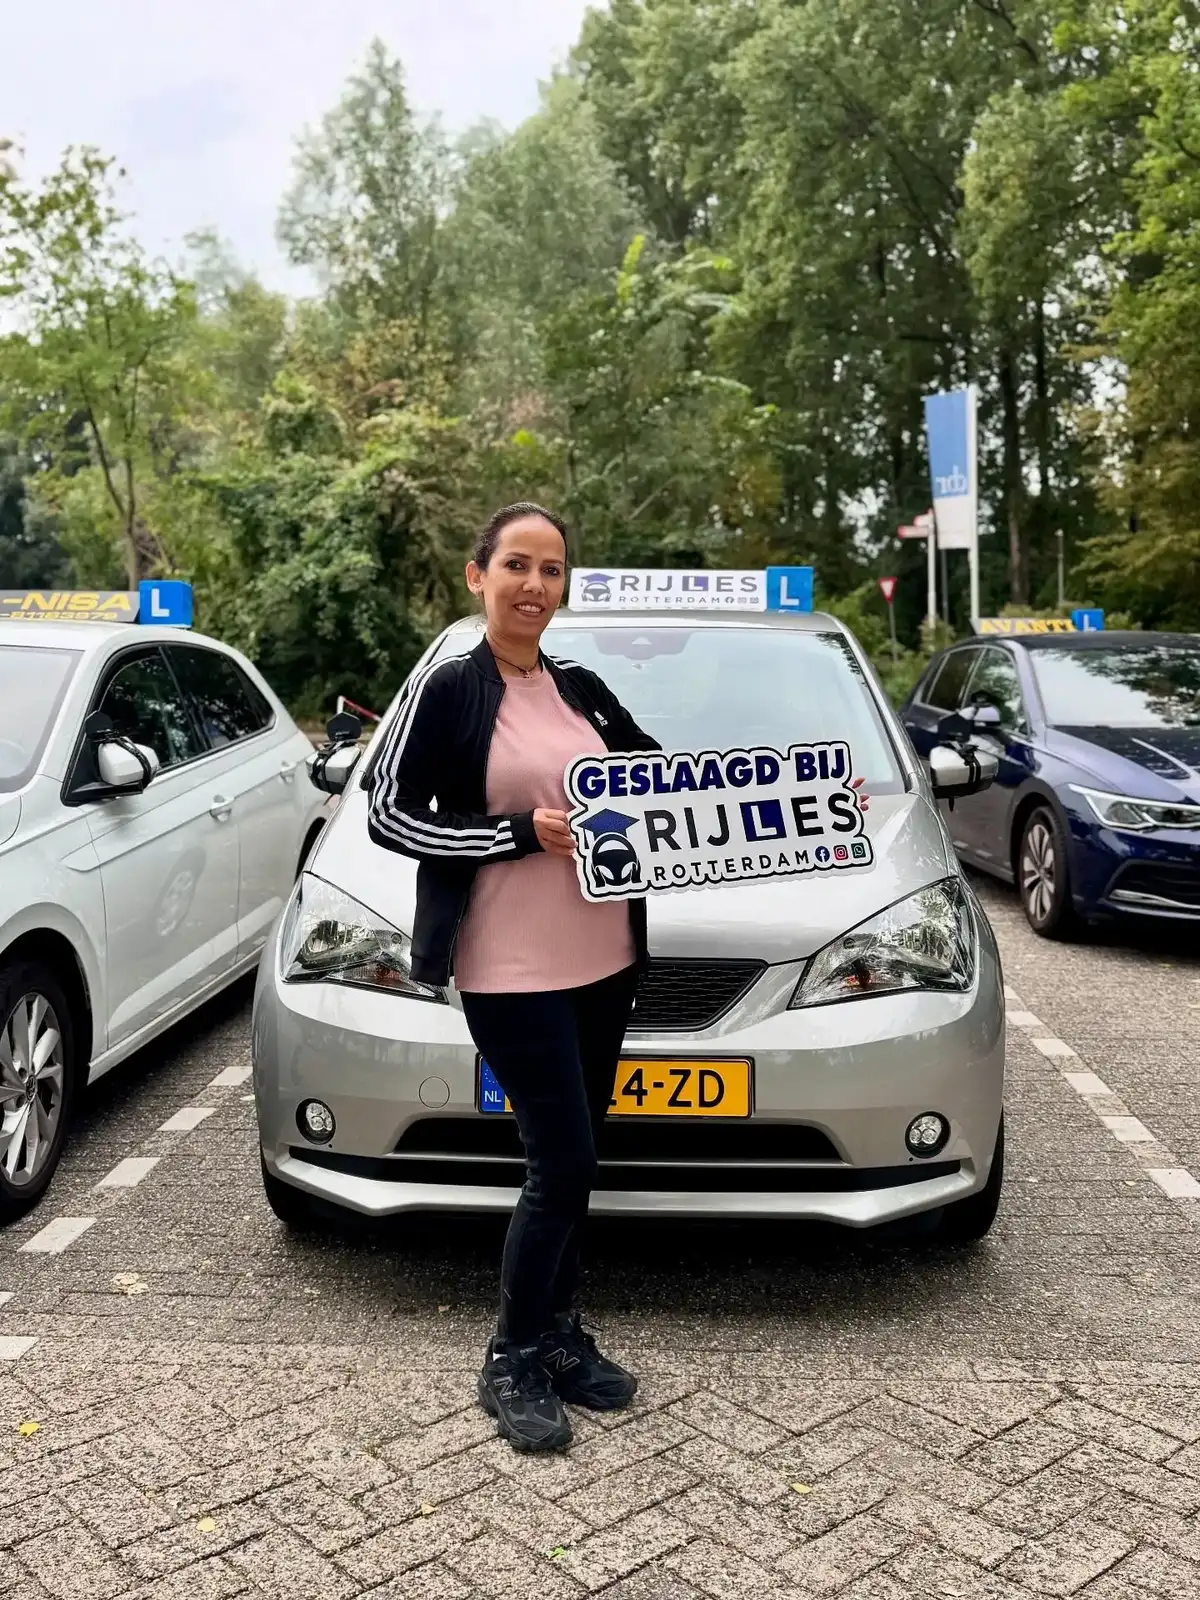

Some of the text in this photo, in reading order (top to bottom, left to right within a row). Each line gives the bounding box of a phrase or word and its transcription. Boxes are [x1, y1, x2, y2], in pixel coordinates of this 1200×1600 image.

[619, 574, 758, 592] RIJLES
[780, 575, 800, 606] L
[151, 588, 170, 617] L
[619, 596, 721, 605] ROTTERDAM
[980, 618, 1078, 634] AVANTI
[1082, 613, 1098, 633] L
[577, 747, 846, 800] GESLAAGD BIJ
[643, 792, 859, 853] RIJLES
[653, 849, 810, 882] ROTTERDAM
[484, 1090, 502, 1103] NL
[610, 1067, 725, 1108] 4-ZD
